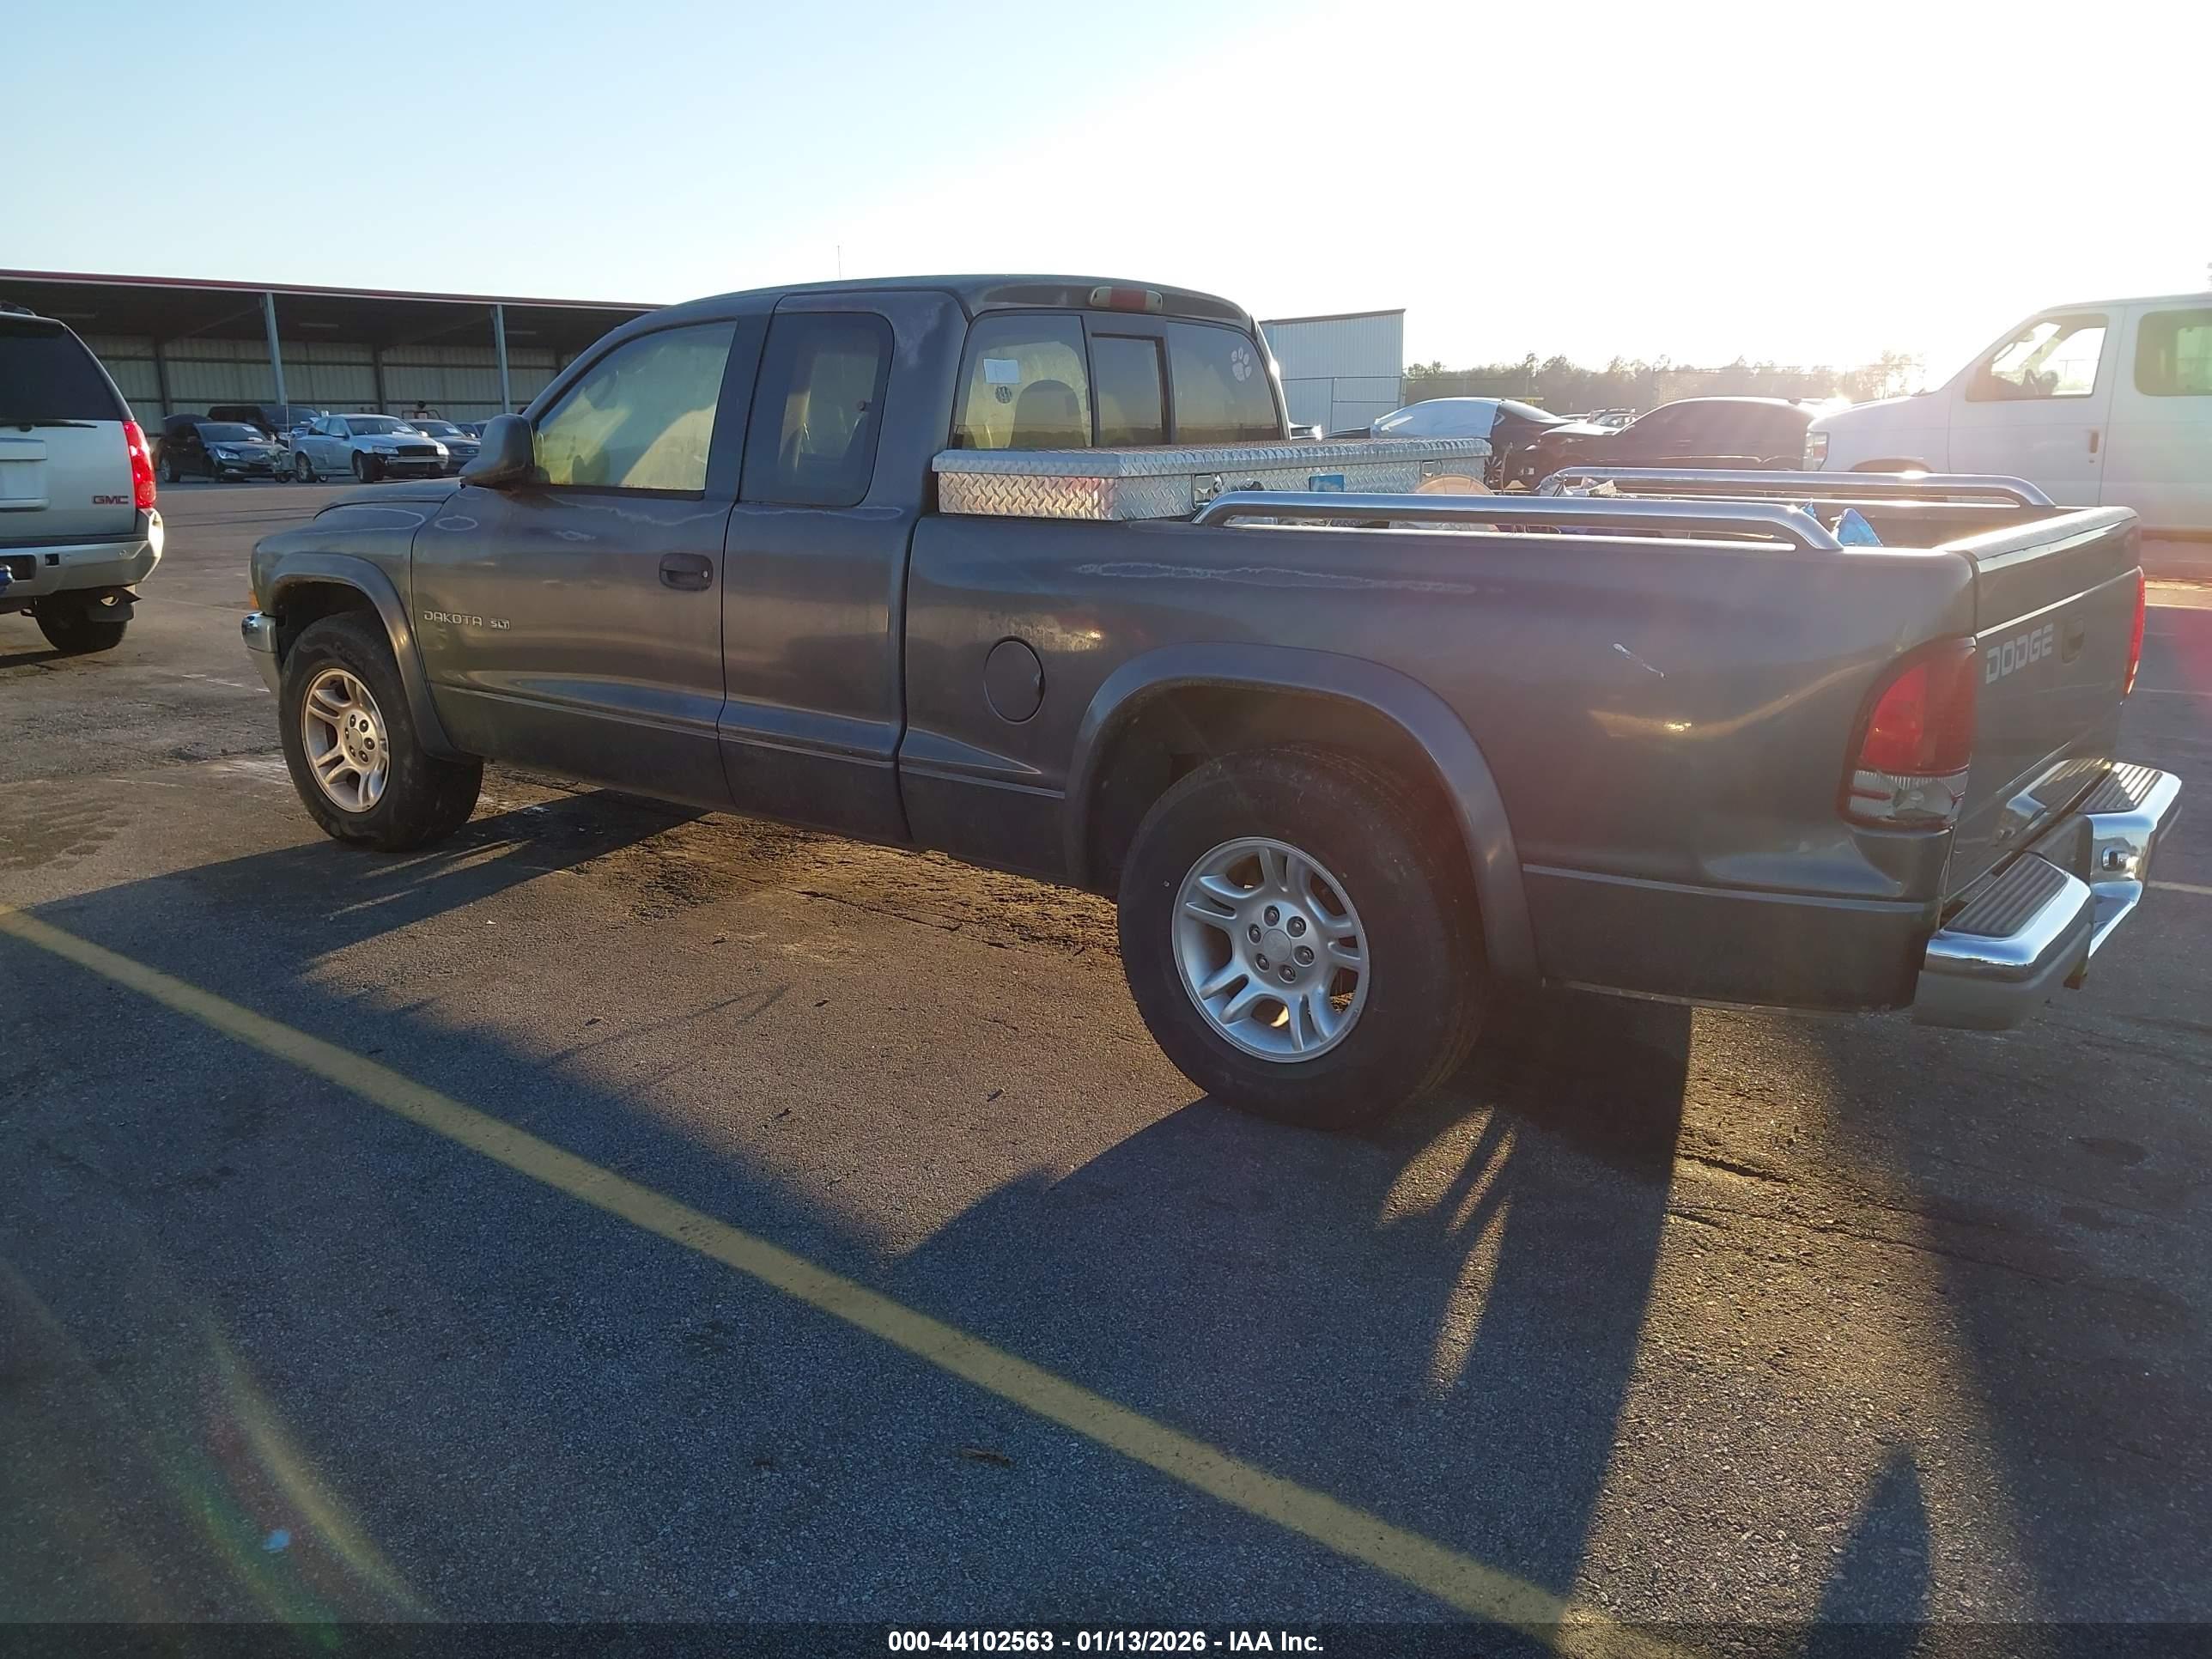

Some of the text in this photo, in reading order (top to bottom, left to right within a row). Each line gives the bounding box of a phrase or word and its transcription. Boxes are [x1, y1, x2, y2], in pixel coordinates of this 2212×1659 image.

[92, 495, 129, 505] GMC
[423, 610, 511, 630] DAKOTA SLT
[1985, 623, 2054, 684] DODGE
